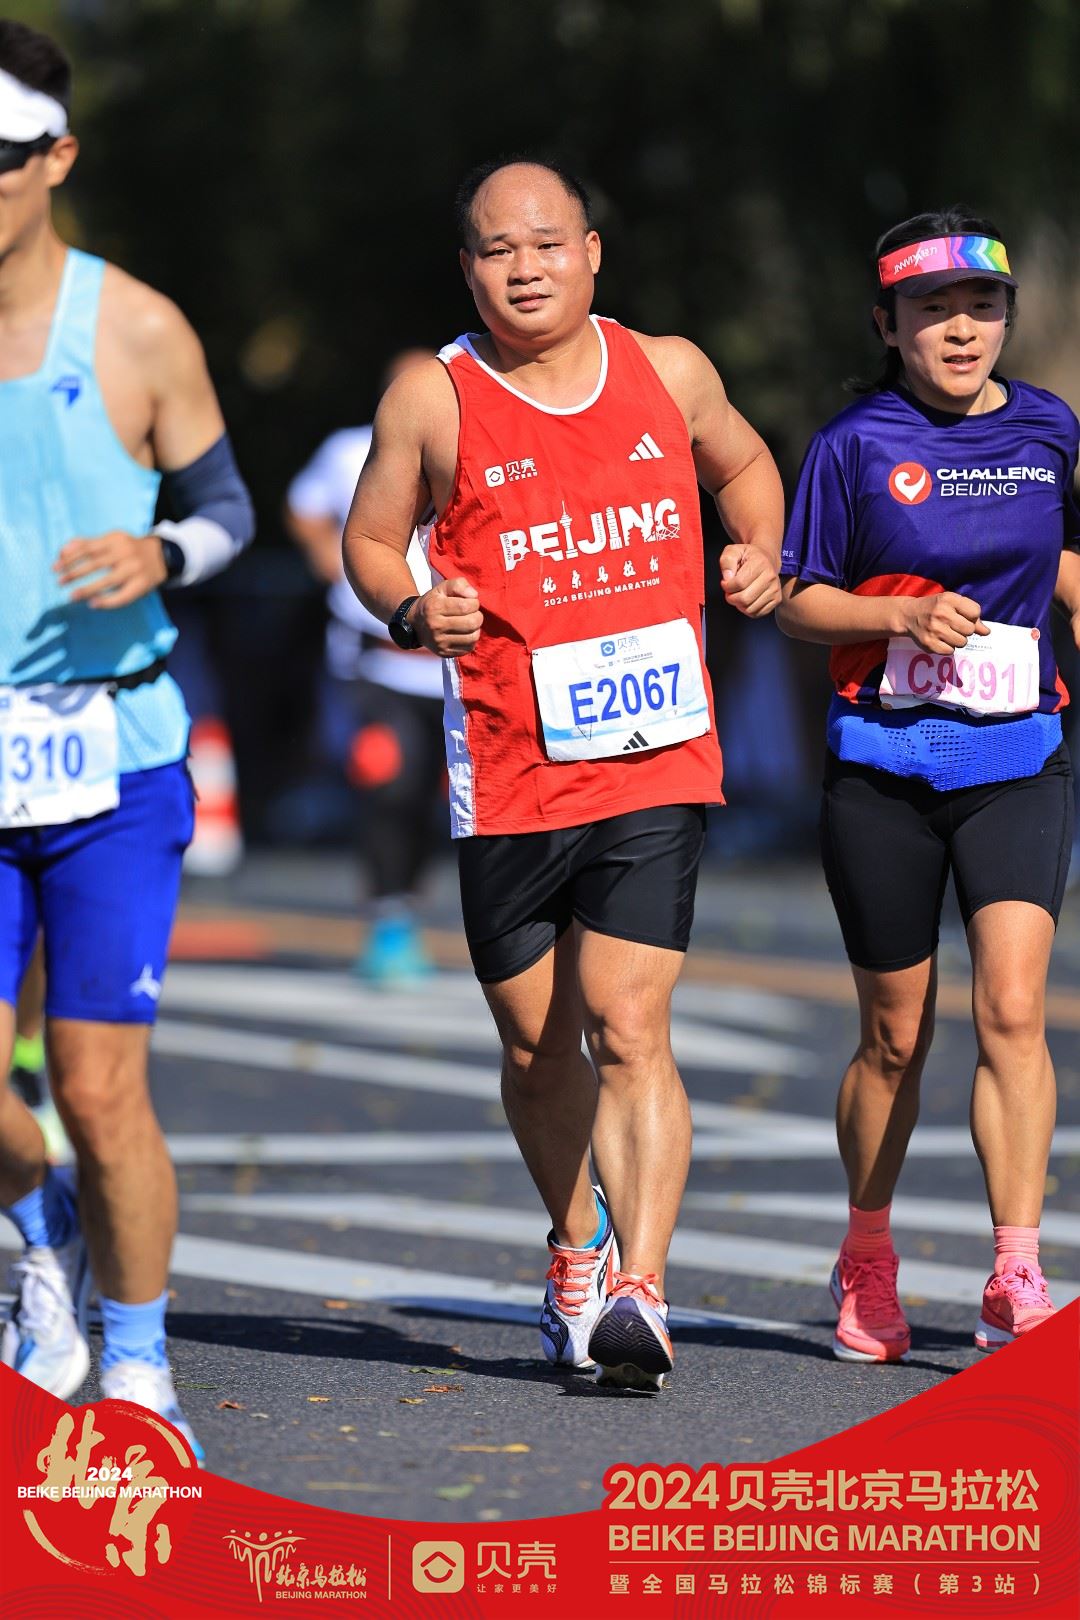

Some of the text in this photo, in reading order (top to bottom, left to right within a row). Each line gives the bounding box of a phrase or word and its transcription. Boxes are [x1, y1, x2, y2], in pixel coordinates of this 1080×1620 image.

[506, 458, 536, 476] 贝壳
[936, 466, 1056, 485] CHALLENGE
[940, 482, 1018, 497] BEIJING
[499, 498, 680, 571] BEIJING
[544, 577, 660, 608] 2024 BEIJING MARATHON
[568, 662, 681, 726] E2067
[0, 731, 86, 785] 310
